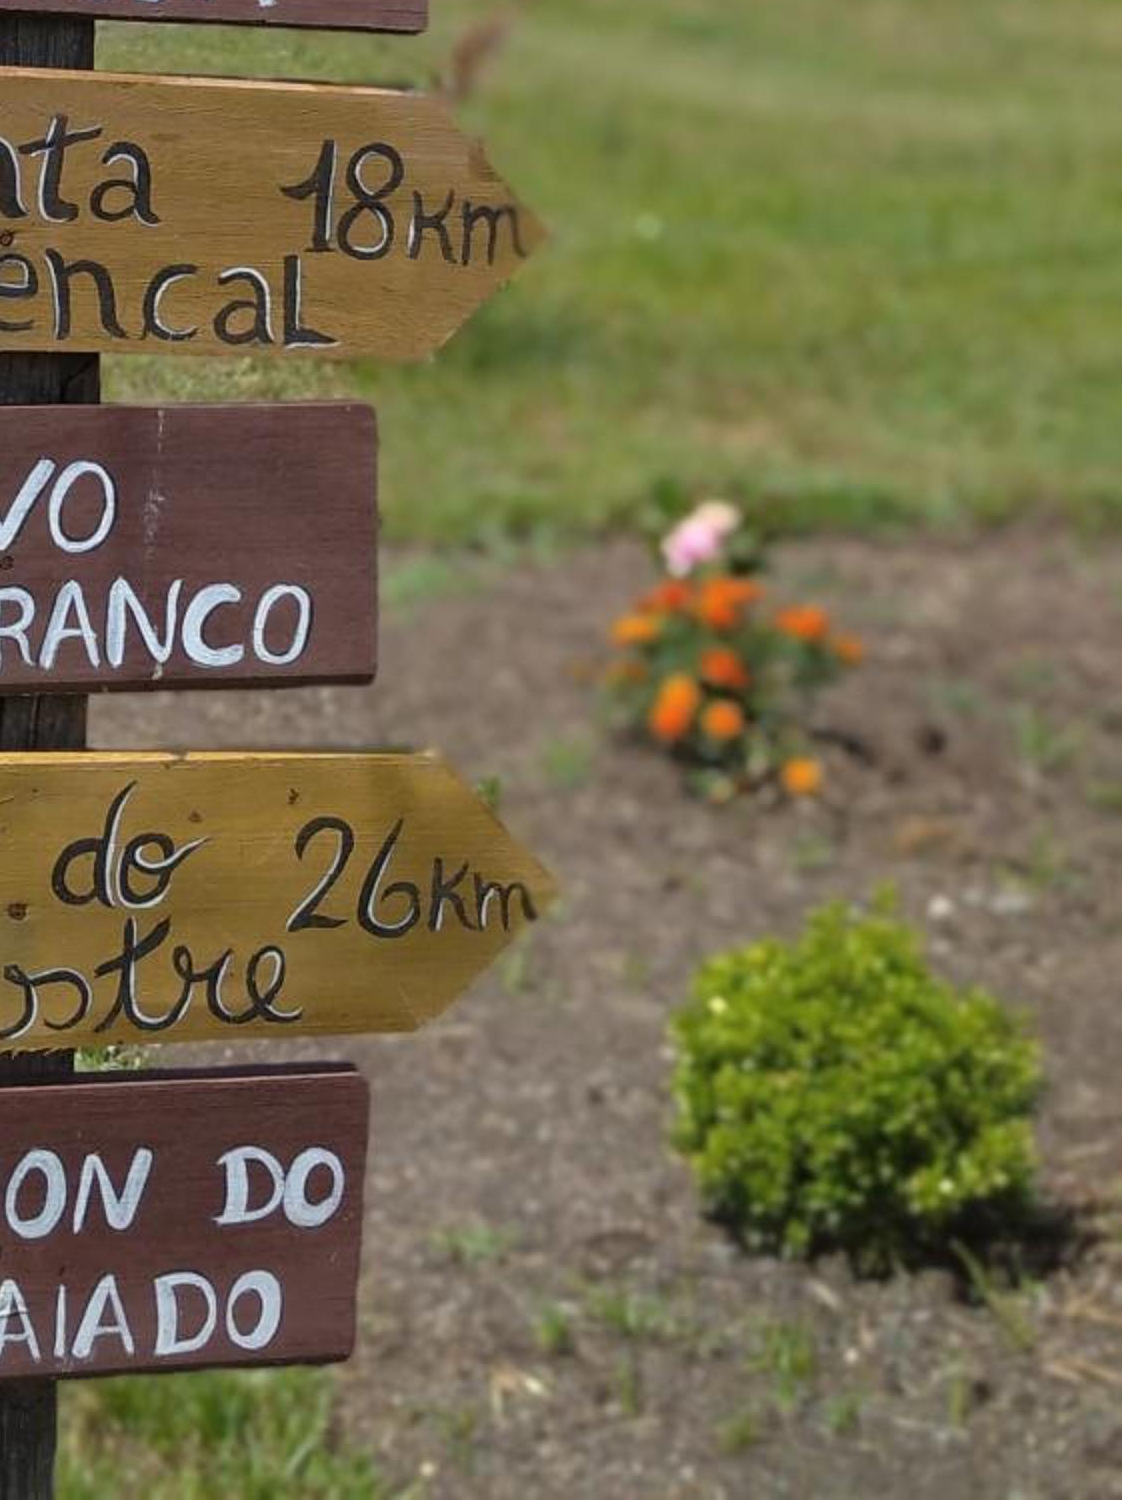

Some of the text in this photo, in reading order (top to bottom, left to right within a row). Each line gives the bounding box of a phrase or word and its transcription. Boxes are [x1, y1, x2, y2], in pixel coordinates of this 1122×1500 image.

[280, 138, 403, 260] 18
[51, 780, 213, 910] do
[285, 815, 420, 938] 26
[213, 1144, 346, 1228] DO
